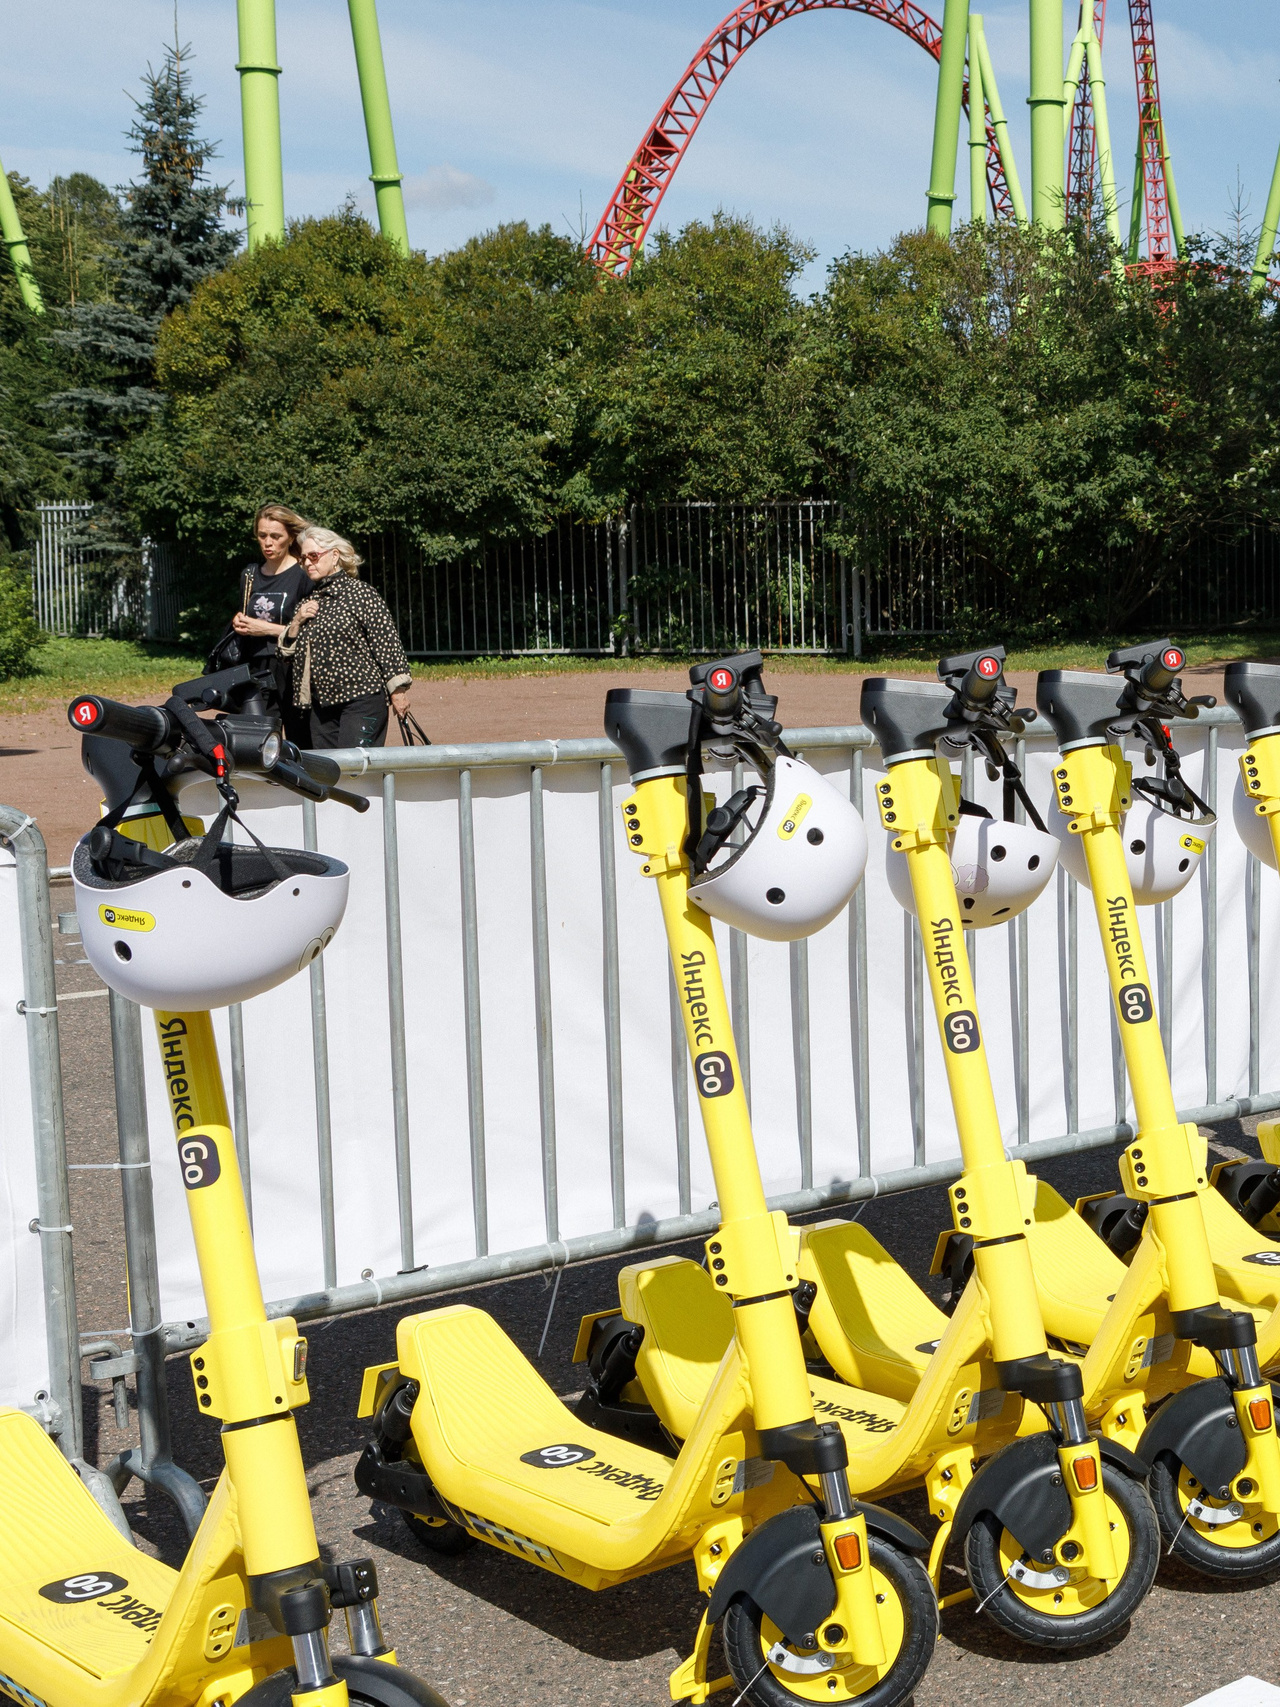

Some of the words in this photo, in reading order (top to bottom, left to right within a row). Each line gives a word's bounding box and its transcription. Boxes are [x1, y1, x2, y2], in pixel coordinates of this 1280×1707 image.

[983, 661, 993, 673] Я
[1168, 653, 1177, 664] Я
[716, 672, 726, 685] Я
[80, 705, 91, 721] Я
[117, 913, 146, 926] Яндекс
[1106, 896, 1136, 980] Яндекс
[1124, 988, 1146, 1020] Go
[930, 918, 963, 1006] Яндекс
[950, 1015, 973, 1049] Go
[681, 950, 714, 1047] Яндекс
[700, 1056, 725, 1094] Go
[159, 1018, 195, 1130] Яндекс
[181, 1141, 209, 1185] Go
[64, 1574, 113, 1598] Go
[97, 1594, 163, 1644] декс
